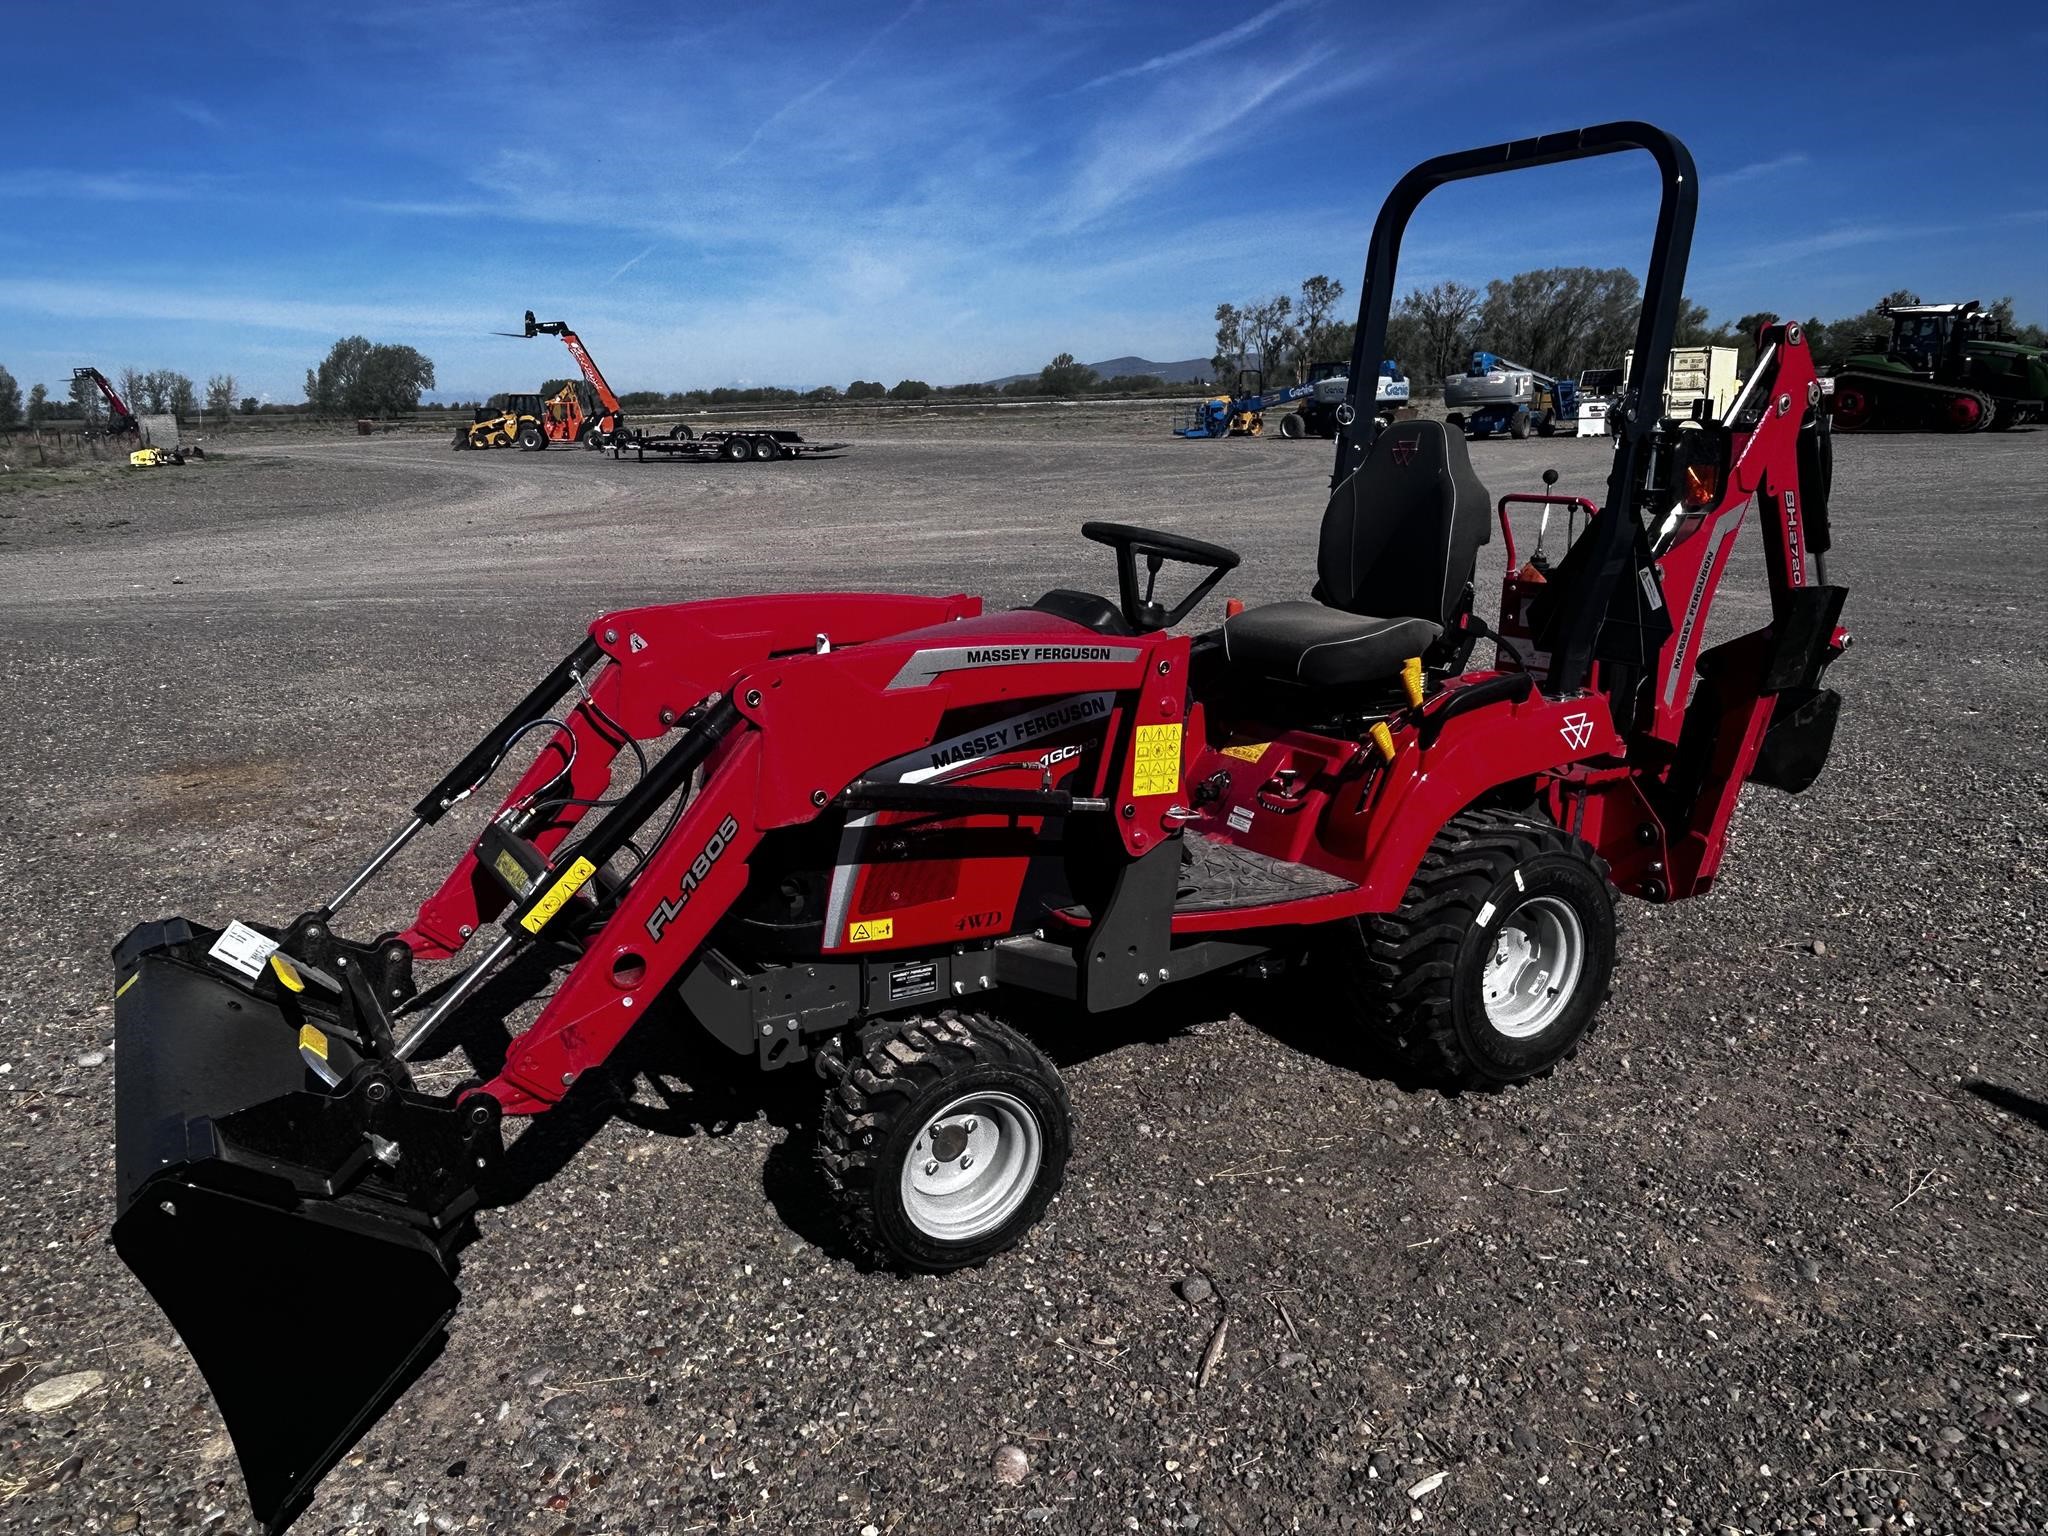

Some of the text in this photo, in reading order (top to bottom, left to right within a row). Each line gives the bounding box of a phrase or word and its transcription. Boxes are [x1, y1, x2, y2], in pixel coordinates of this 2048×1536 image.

[1384, 383, 1409, 397] Genie
[1784, 490, 1803, 585] BH.2720
[1673, 620, 1693, 670] MASSEY
[1689, 551, 1714, 617] FERGUSON
[967, 647, 1111, 664] MASSEY FERGUSON
[931, 696, 1106, 770] MASSEY FERGUSON
[644, 812, 741, 944] FL.1805
[954, 911, 1003, 932] 4WD
